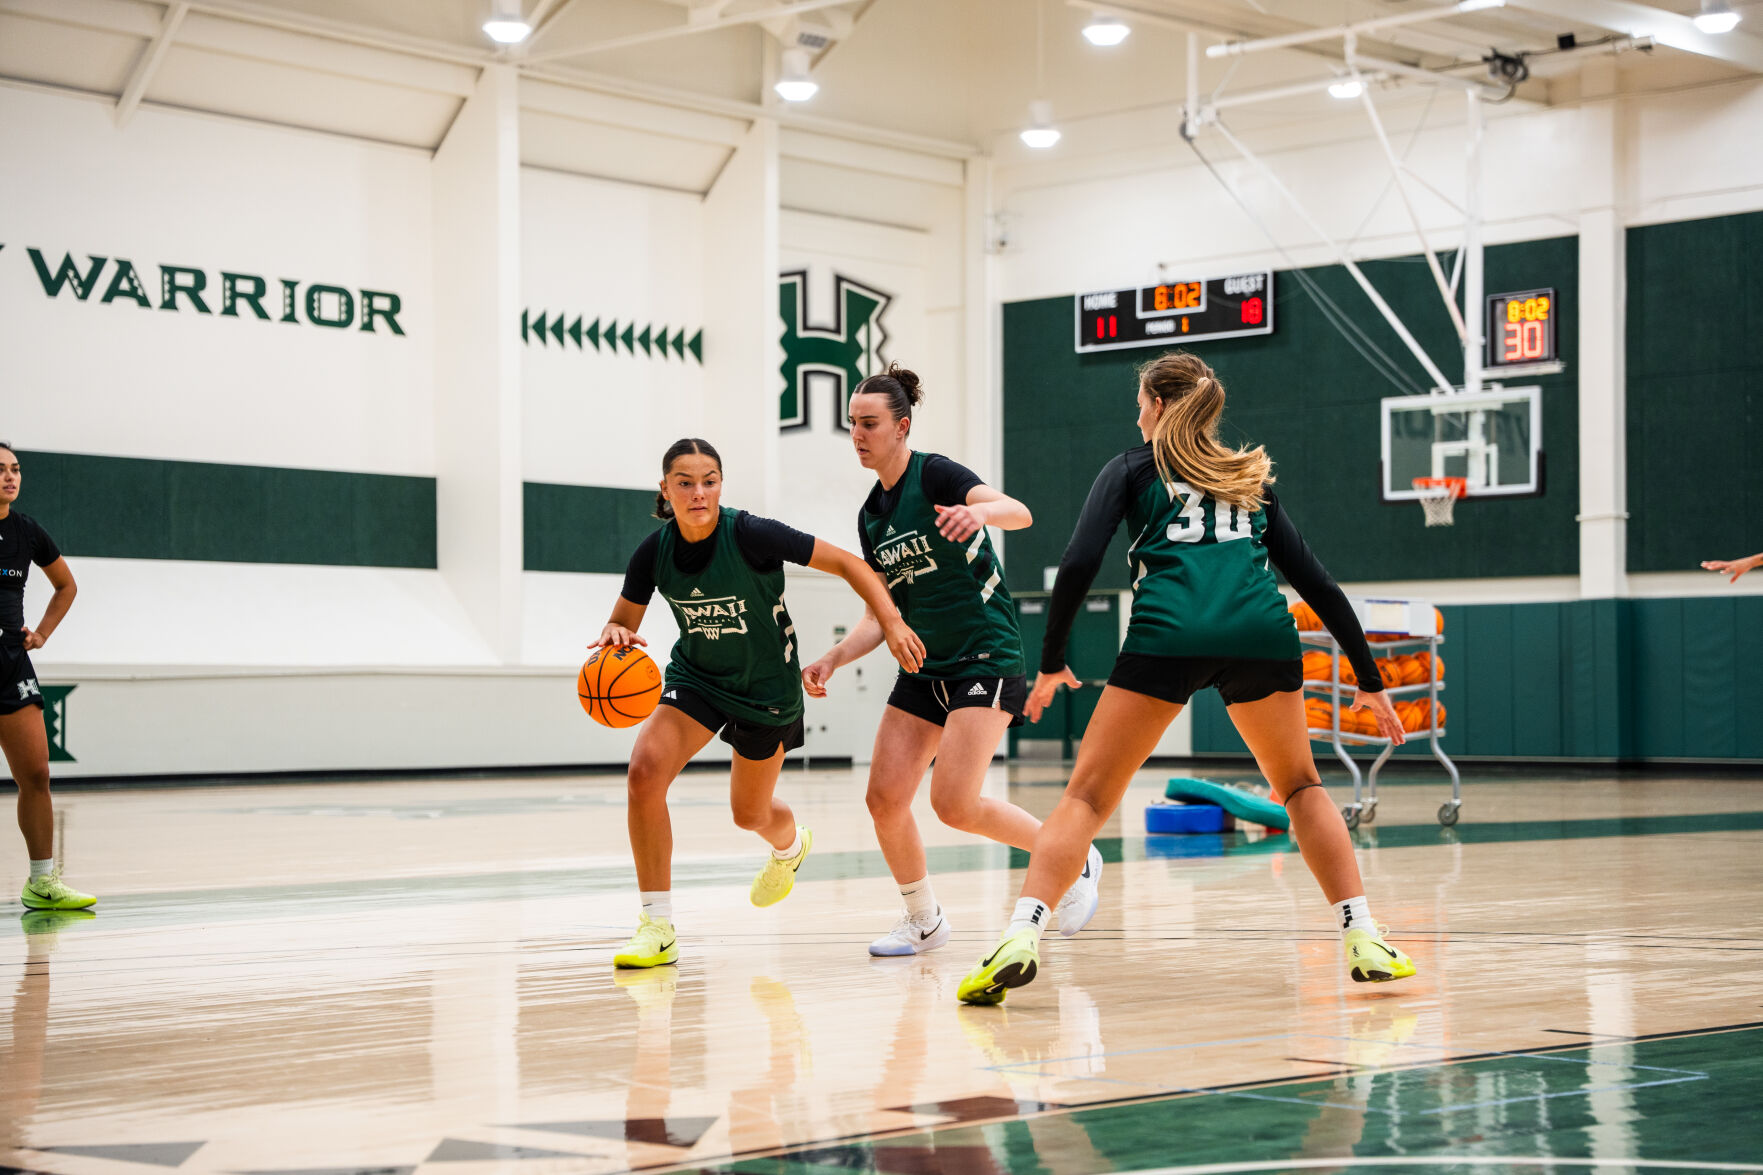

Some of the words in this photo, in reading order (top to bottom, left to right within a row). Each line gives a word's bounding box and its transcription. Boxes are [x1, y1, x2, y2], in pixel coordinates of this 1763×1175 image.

[26, 247, 406, 336] WARRIOR
[1083, 293, 1118, 311] HOME
[1154, 282, 1201, 311] 8:02
[1507, 297, 1550, 323] 8:02
[1097, 315, 1117, 338] 11
[1504, 320, 1543, 360] 30
[880, 535, 933, 566] AWAII
[0, 568, 23, 577] XON
